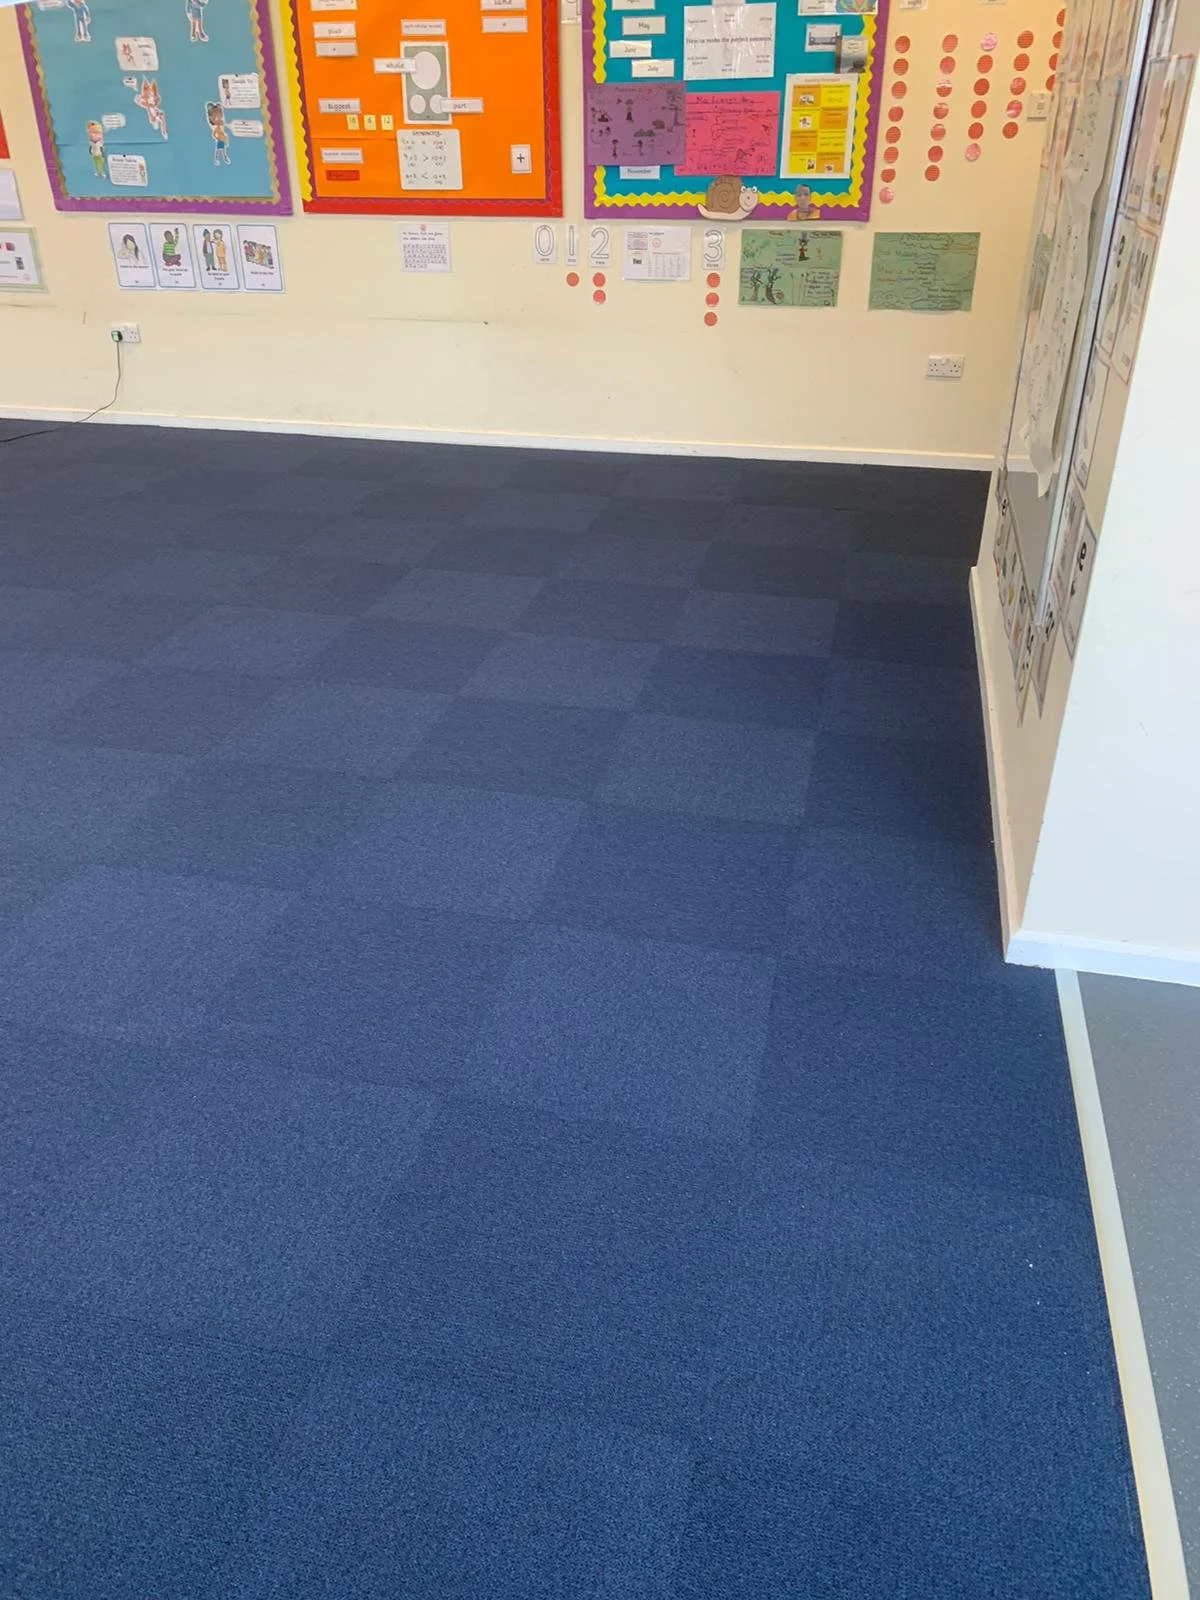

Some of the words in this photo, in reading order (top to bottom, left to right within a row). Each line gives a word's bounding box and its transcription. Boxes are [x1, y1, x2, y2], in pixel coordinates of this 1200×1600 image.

[638, 22, 650, 30] May
[535, 225, 554, 256] 0
[591, 227, 609, 258] 2
[704, 230, 722, 262] 3
